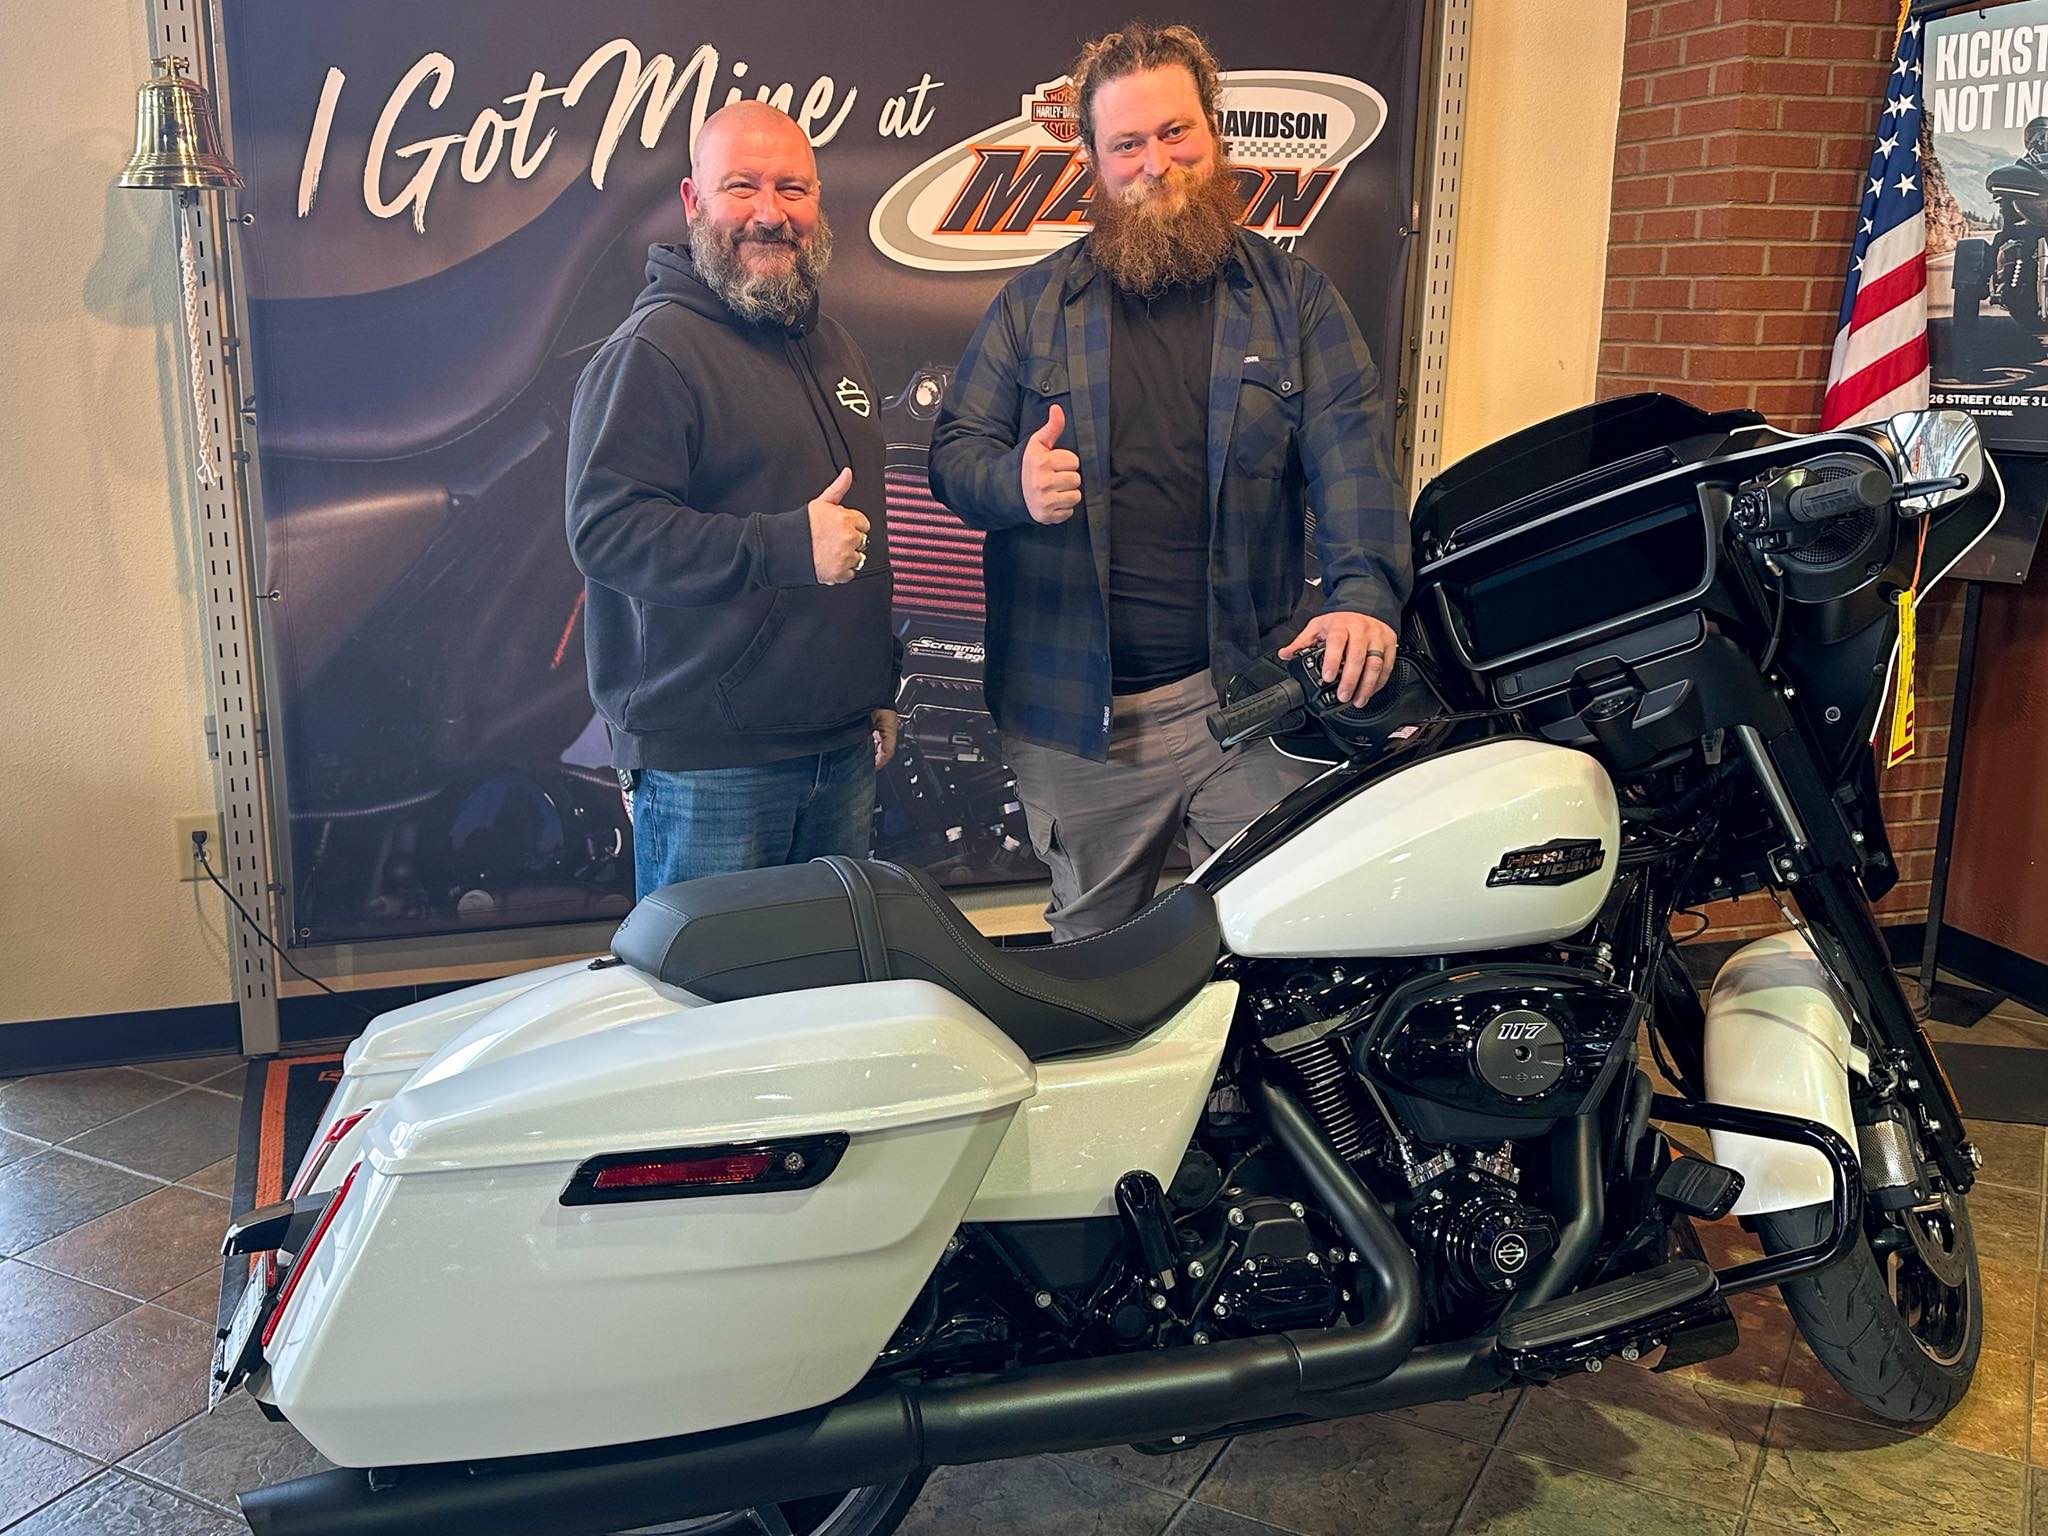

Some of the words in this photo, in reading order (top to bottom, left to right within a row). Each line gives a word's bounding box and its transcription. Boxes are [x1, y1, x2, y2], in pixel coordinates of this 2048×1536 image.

[1035, 105, 1081, 119] HARLEY-D
[1933, 83, 2000, 135] NOT
[2003, 79, 2048, 130] IN
[1049, 122, 1076, 138] CYCLE
[298, 66, 345, 218] I
[363, 51, 566, 234] Got
[878, 72, 944, 138] at
[932, 147, 1340, 236] MAN
[1946, 394, 1992, 405] STREET
[1993, 395, 2029, 406] GLIDE
[2032, 396, 2040, 406] 3
[953, 651, 986, 662] Eagl
[1497, 1022, 1548, 1040] 117
